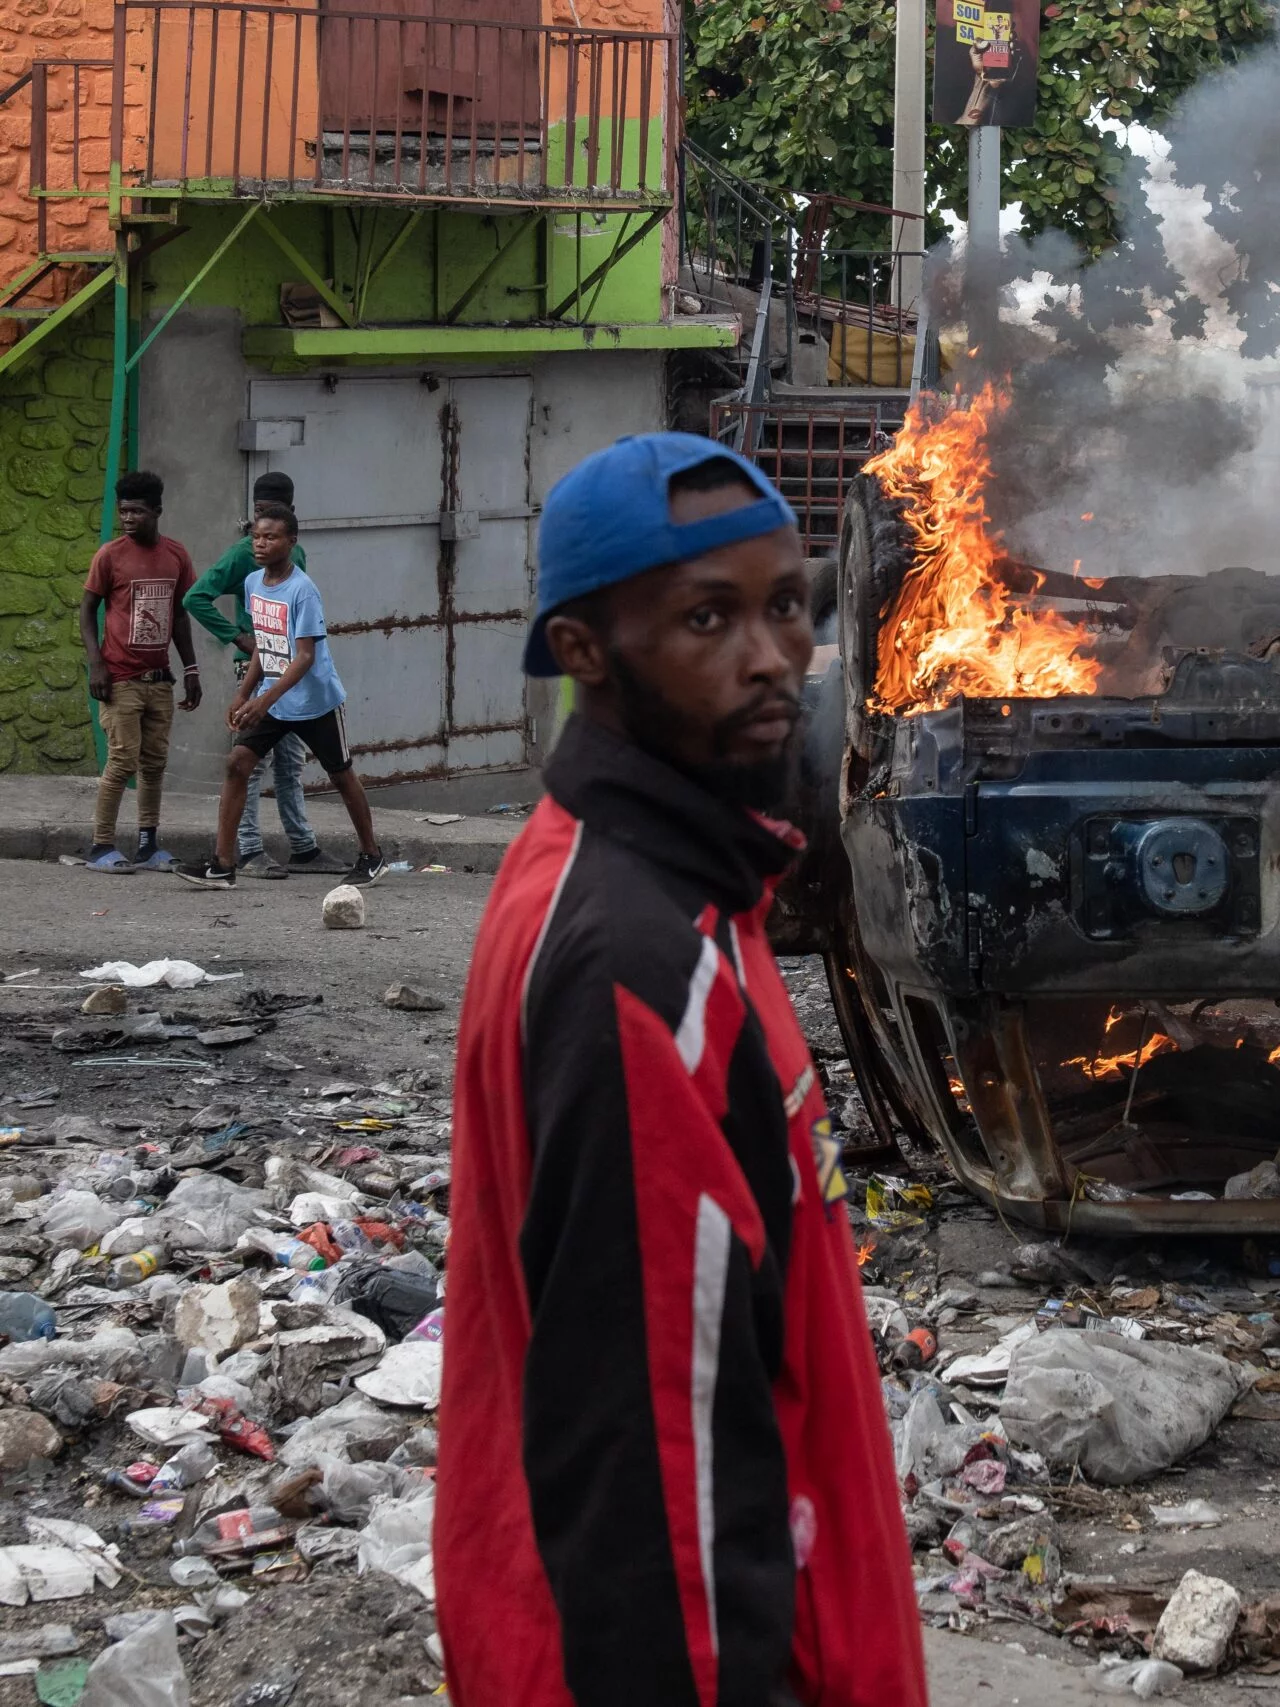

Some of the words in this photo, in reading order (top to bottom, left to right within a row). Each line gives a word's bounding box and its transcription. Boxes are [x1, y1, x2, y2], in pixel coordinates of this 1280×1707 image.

[957, 5, 980, 21] SOU
[960, 25, 975, 41] SA
[253, 598, 263, 613] DO
[265, 602, 281, 617] NOT
[252, 611, 283, 631] DISTURB
